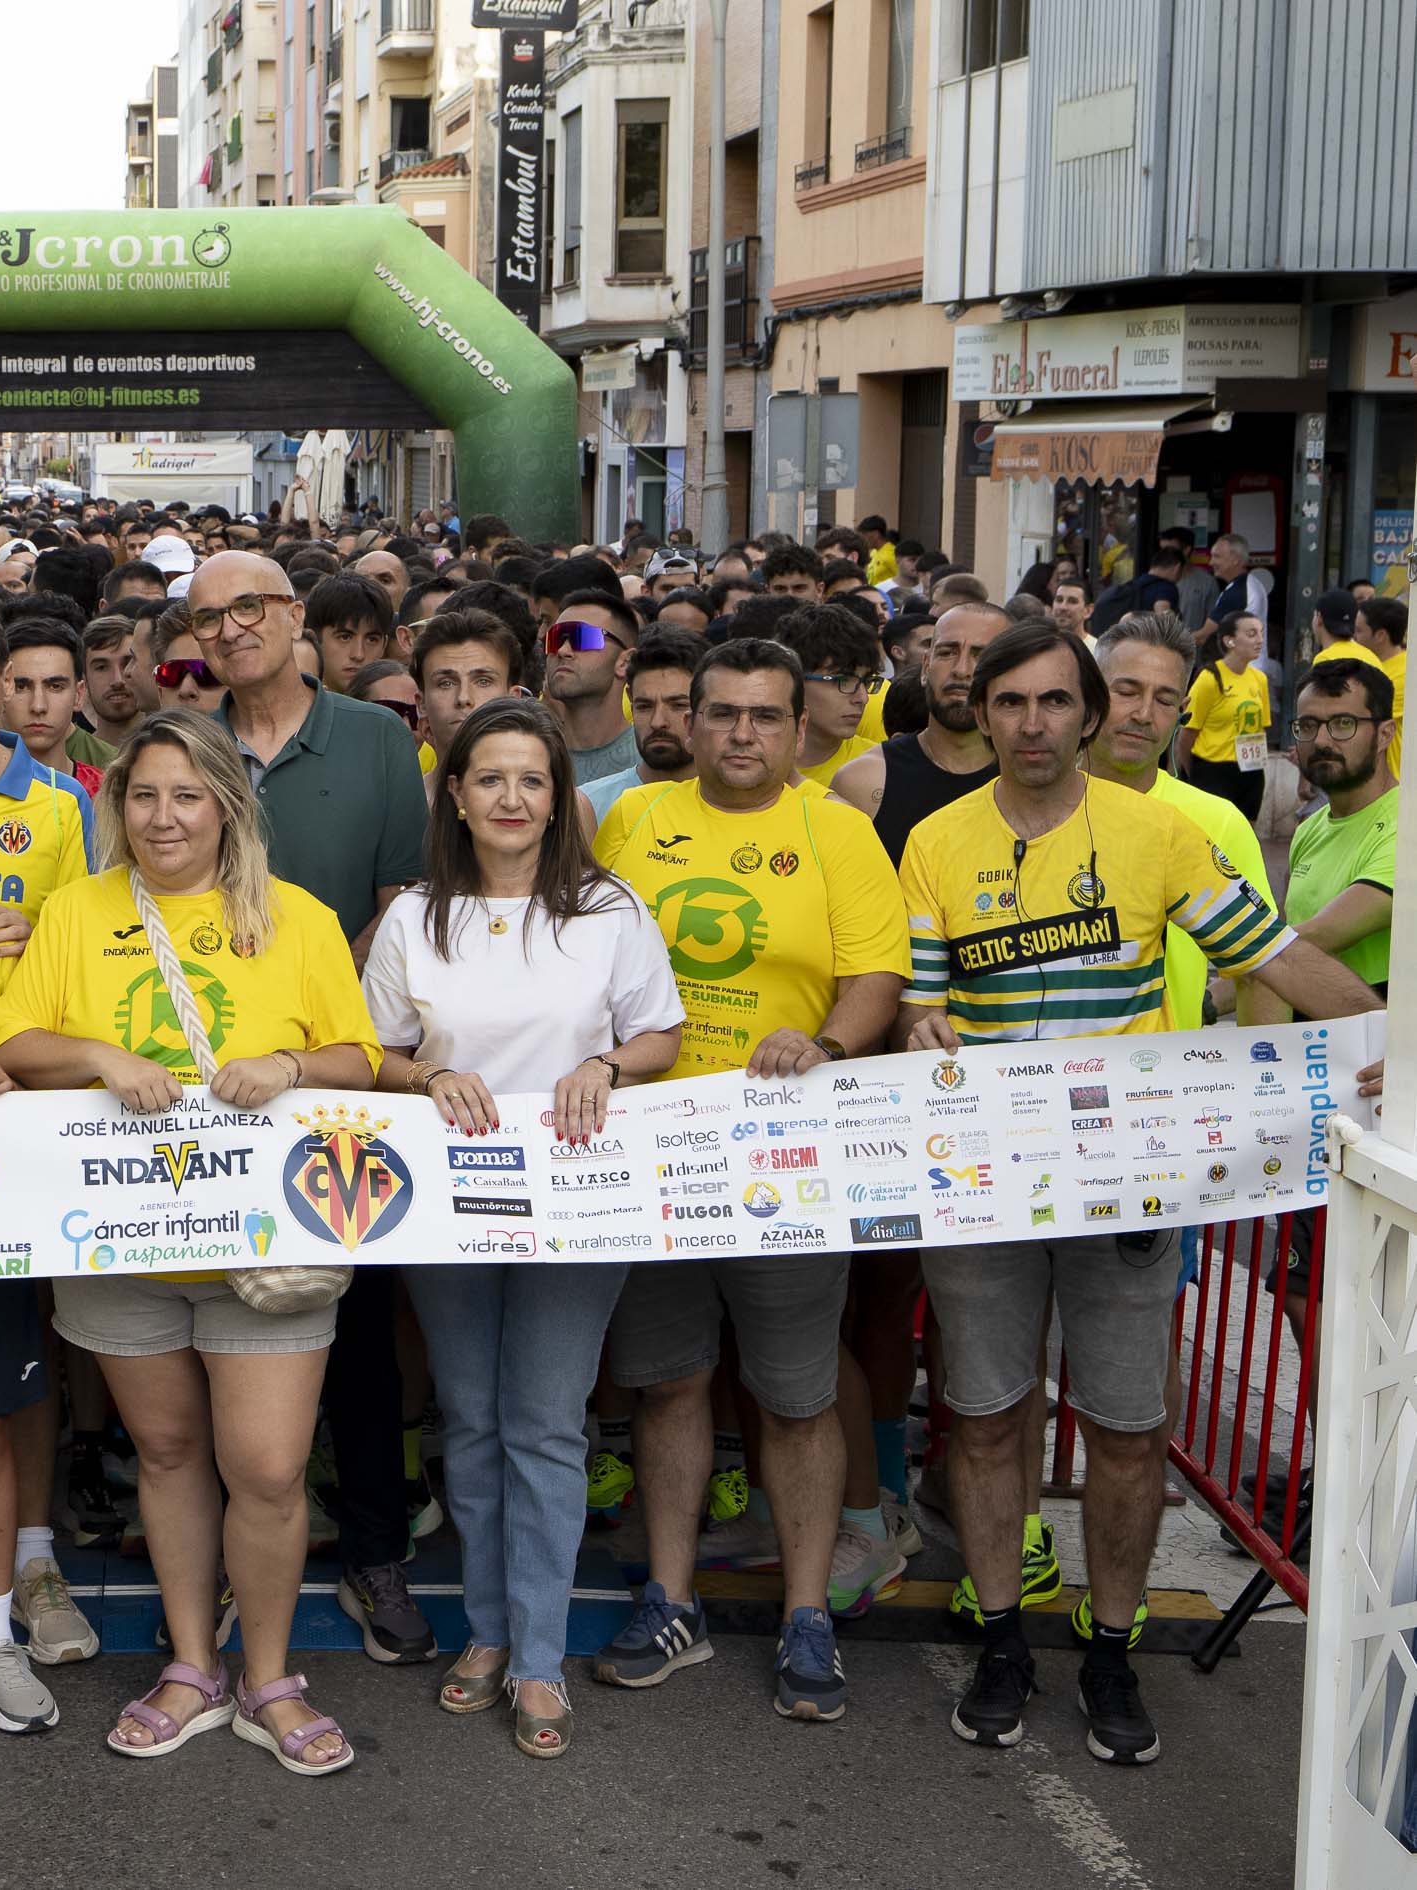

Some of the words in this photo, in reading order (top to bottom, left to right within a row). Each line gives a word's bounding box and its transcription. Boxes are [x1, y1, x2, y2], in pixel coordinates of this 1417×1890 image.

[507, 83, 541, 98] Kebab
[504, 100, 543, 114] Comida
[509, 117, 539, 130] Turca
[506, 144, 538, 283] Estambul
[15, 274, 102, 291] PROFESIONAL
[107, 274, 123, 290] DE
[128, 271, 230, 290] CRONOMETRAJE
[374, 262, 513, 394] www.hj-crono.es
[1187, 340, 1228, 350] BOLSAS
[1134, 348, 1170, 366] LLEPOLIES
[2, 356, 66, 374] integral
[73, 356, 93, 372] de
[97, 356, 162, 372] eventos
[166, 355, 255, 373] deportivos
[991, 353, 1010, 393] El
[1036, 345, 1119, 392] Fumeral
[133, 447, 195, 469] Madrigal
[1050, 435, 1100, 472] KIOSC
[1242, 746, 1260, 759] 819
[647, 850, 690, 867] ENDAVANT
[977, 869, 1014, 883] GOBIK
[959, 936, 1014, 971] CELTIC
[1019, 914, 1112, 956] SUBMARÍ
[104, 945, 151, 958] ENDAVANT
[1081, 951, 1121, 967] VILA-REAL
[706, 984, 720, 992] PER
[722, 987, 758, 996] PARELLES
[691, 991, 758, 1008] SUBMARÍ
[696, 1020, 732, 1036] infantil
[683, 1033, 732, 1047] spanion
[1008, 1064, 1054, 1078] AMBAR
[833, 1078, 859, 1091] A&A
[1253, 1088, 1286, 1097] vila-real
[838, 1095, 887, 1109] podoactiva
[925, 1095, 980, 1107] Ajuntament
[937, 1105, 977, 1116] Vila-real
[1013, 1107, 1040, 1115] disseny
[59, 1119, 106, 1137] JOSÉ
[112, 1118, 184, 1135] MANUEL
[189, 1114, 273, 1129] LLANEZA
[835, 1116, 911, 1129] cifrecerámica
[1072, 1119, 1099, 1130] CREA
[654, 1130, 719, 1149] Isoltec
[550, 1140, 623, 1156] COVALCA
[692, 1144, 720, 1152] Group
[772, 1147, 818, 1169] SACMI
[82, 1140, 253, 1195] ENDAVANT
[677, 1157, 728, 1177] disinel
[474, 1177, 527, 1187] CaixaBank
[552, 1175, 569, 1185] EL
[577, 1171, 630, 1184] VASCO
[927, 1164, 993, 1190] SME
[600, 1182, 631, 1190] CATERING
[870, 1186, 892, 1194] caixa
[894, 1184, 917, 1192] rural
[870, 1193, 906, 1202] vila-real
[934, 1189, 993, 1199] VILA-REAL
[146, 1202, 183, 1210] BENEFICI
[613, 1206, 643, 1214] Marzá
[662, 1204, 733, 1220] FULGOR
[1090, 1206, 1113, 1216] EVA
[761, 1229, 824, 1242] AZAHAR
[871, 1222, 915, 1239] diatall
[61, 1209, 160, 1271] Cáncer
[165, 1210, 239, 1241] infantil
[458, 1240, 529, 1253] vidres
[569, 1234, 652, 1249] ruralnostra
[674, 1234, 736, 1247] incerco
[761, 1241, 827, 1249] ESPECTÁCULOS
[124, 1243, 242, 1267] aspanion
